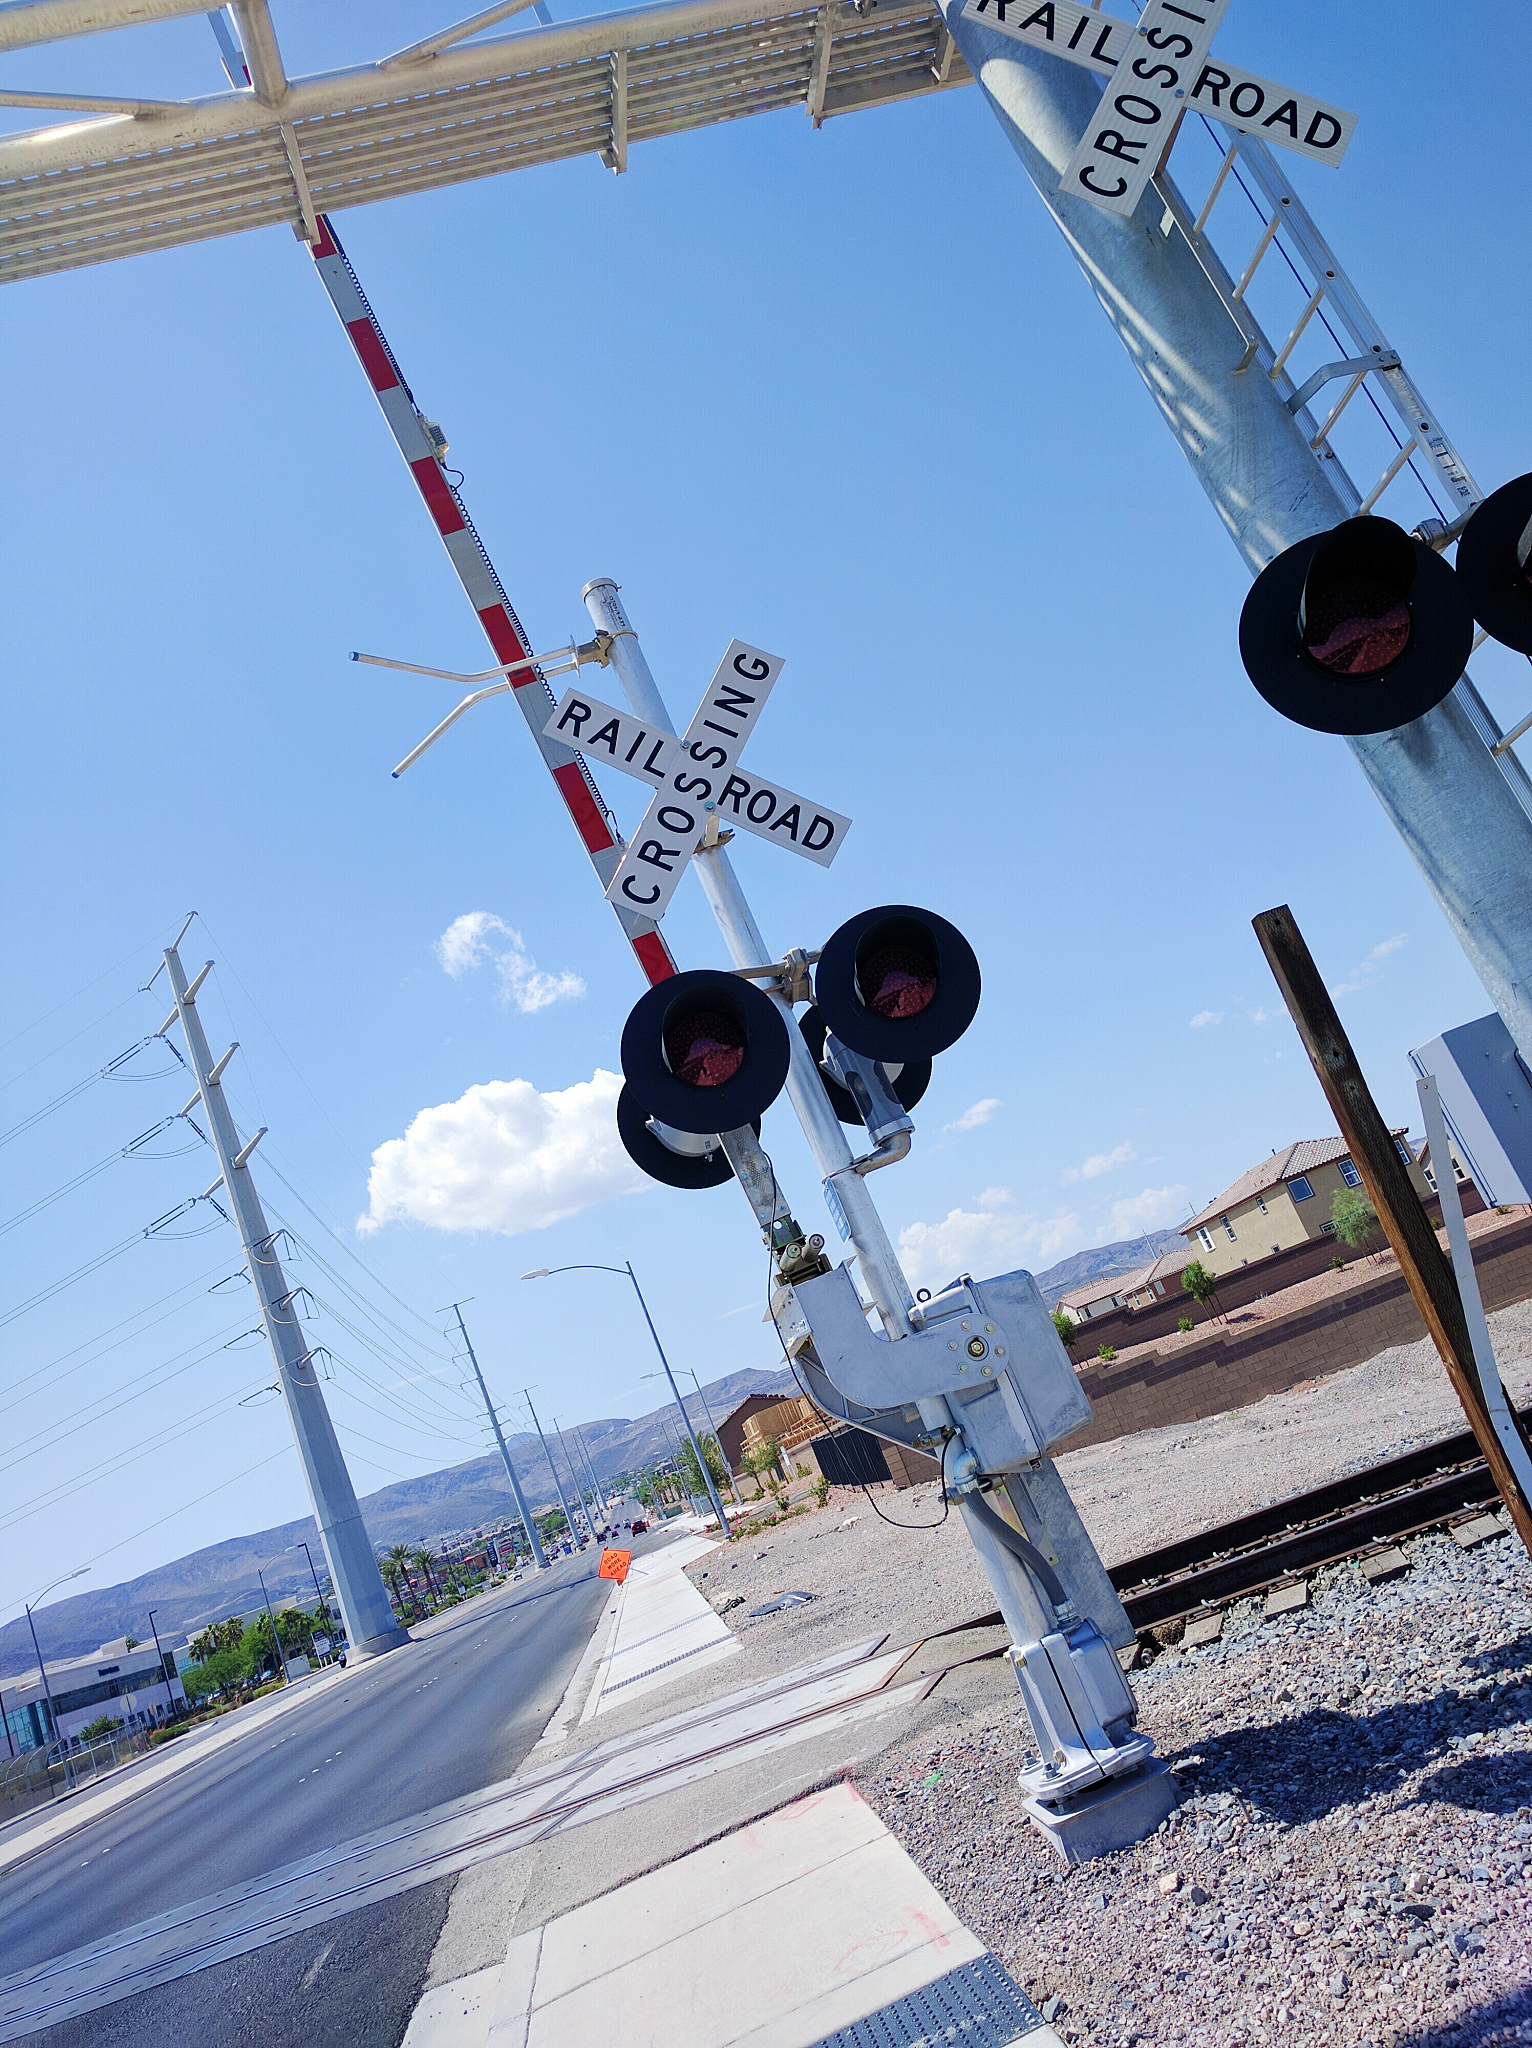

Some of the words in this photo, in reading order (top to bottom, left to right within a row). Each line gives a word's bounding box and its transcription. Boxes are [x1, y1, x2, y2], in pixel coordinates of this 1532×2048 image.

[1079, 0, 1215, 197] CROSSI
[1191, 65, 1342, 149] ROAD
[557, 699, 666, 778] RAIL
[717, 774, 835, 851] ROAD
[622, 653, 770, 905] CROSSING
[604, 1553, 617, 1564] ROAD
[607, 1558, 621, 1570] WORK
[610, 1562, 626, 1576] AHEAD
